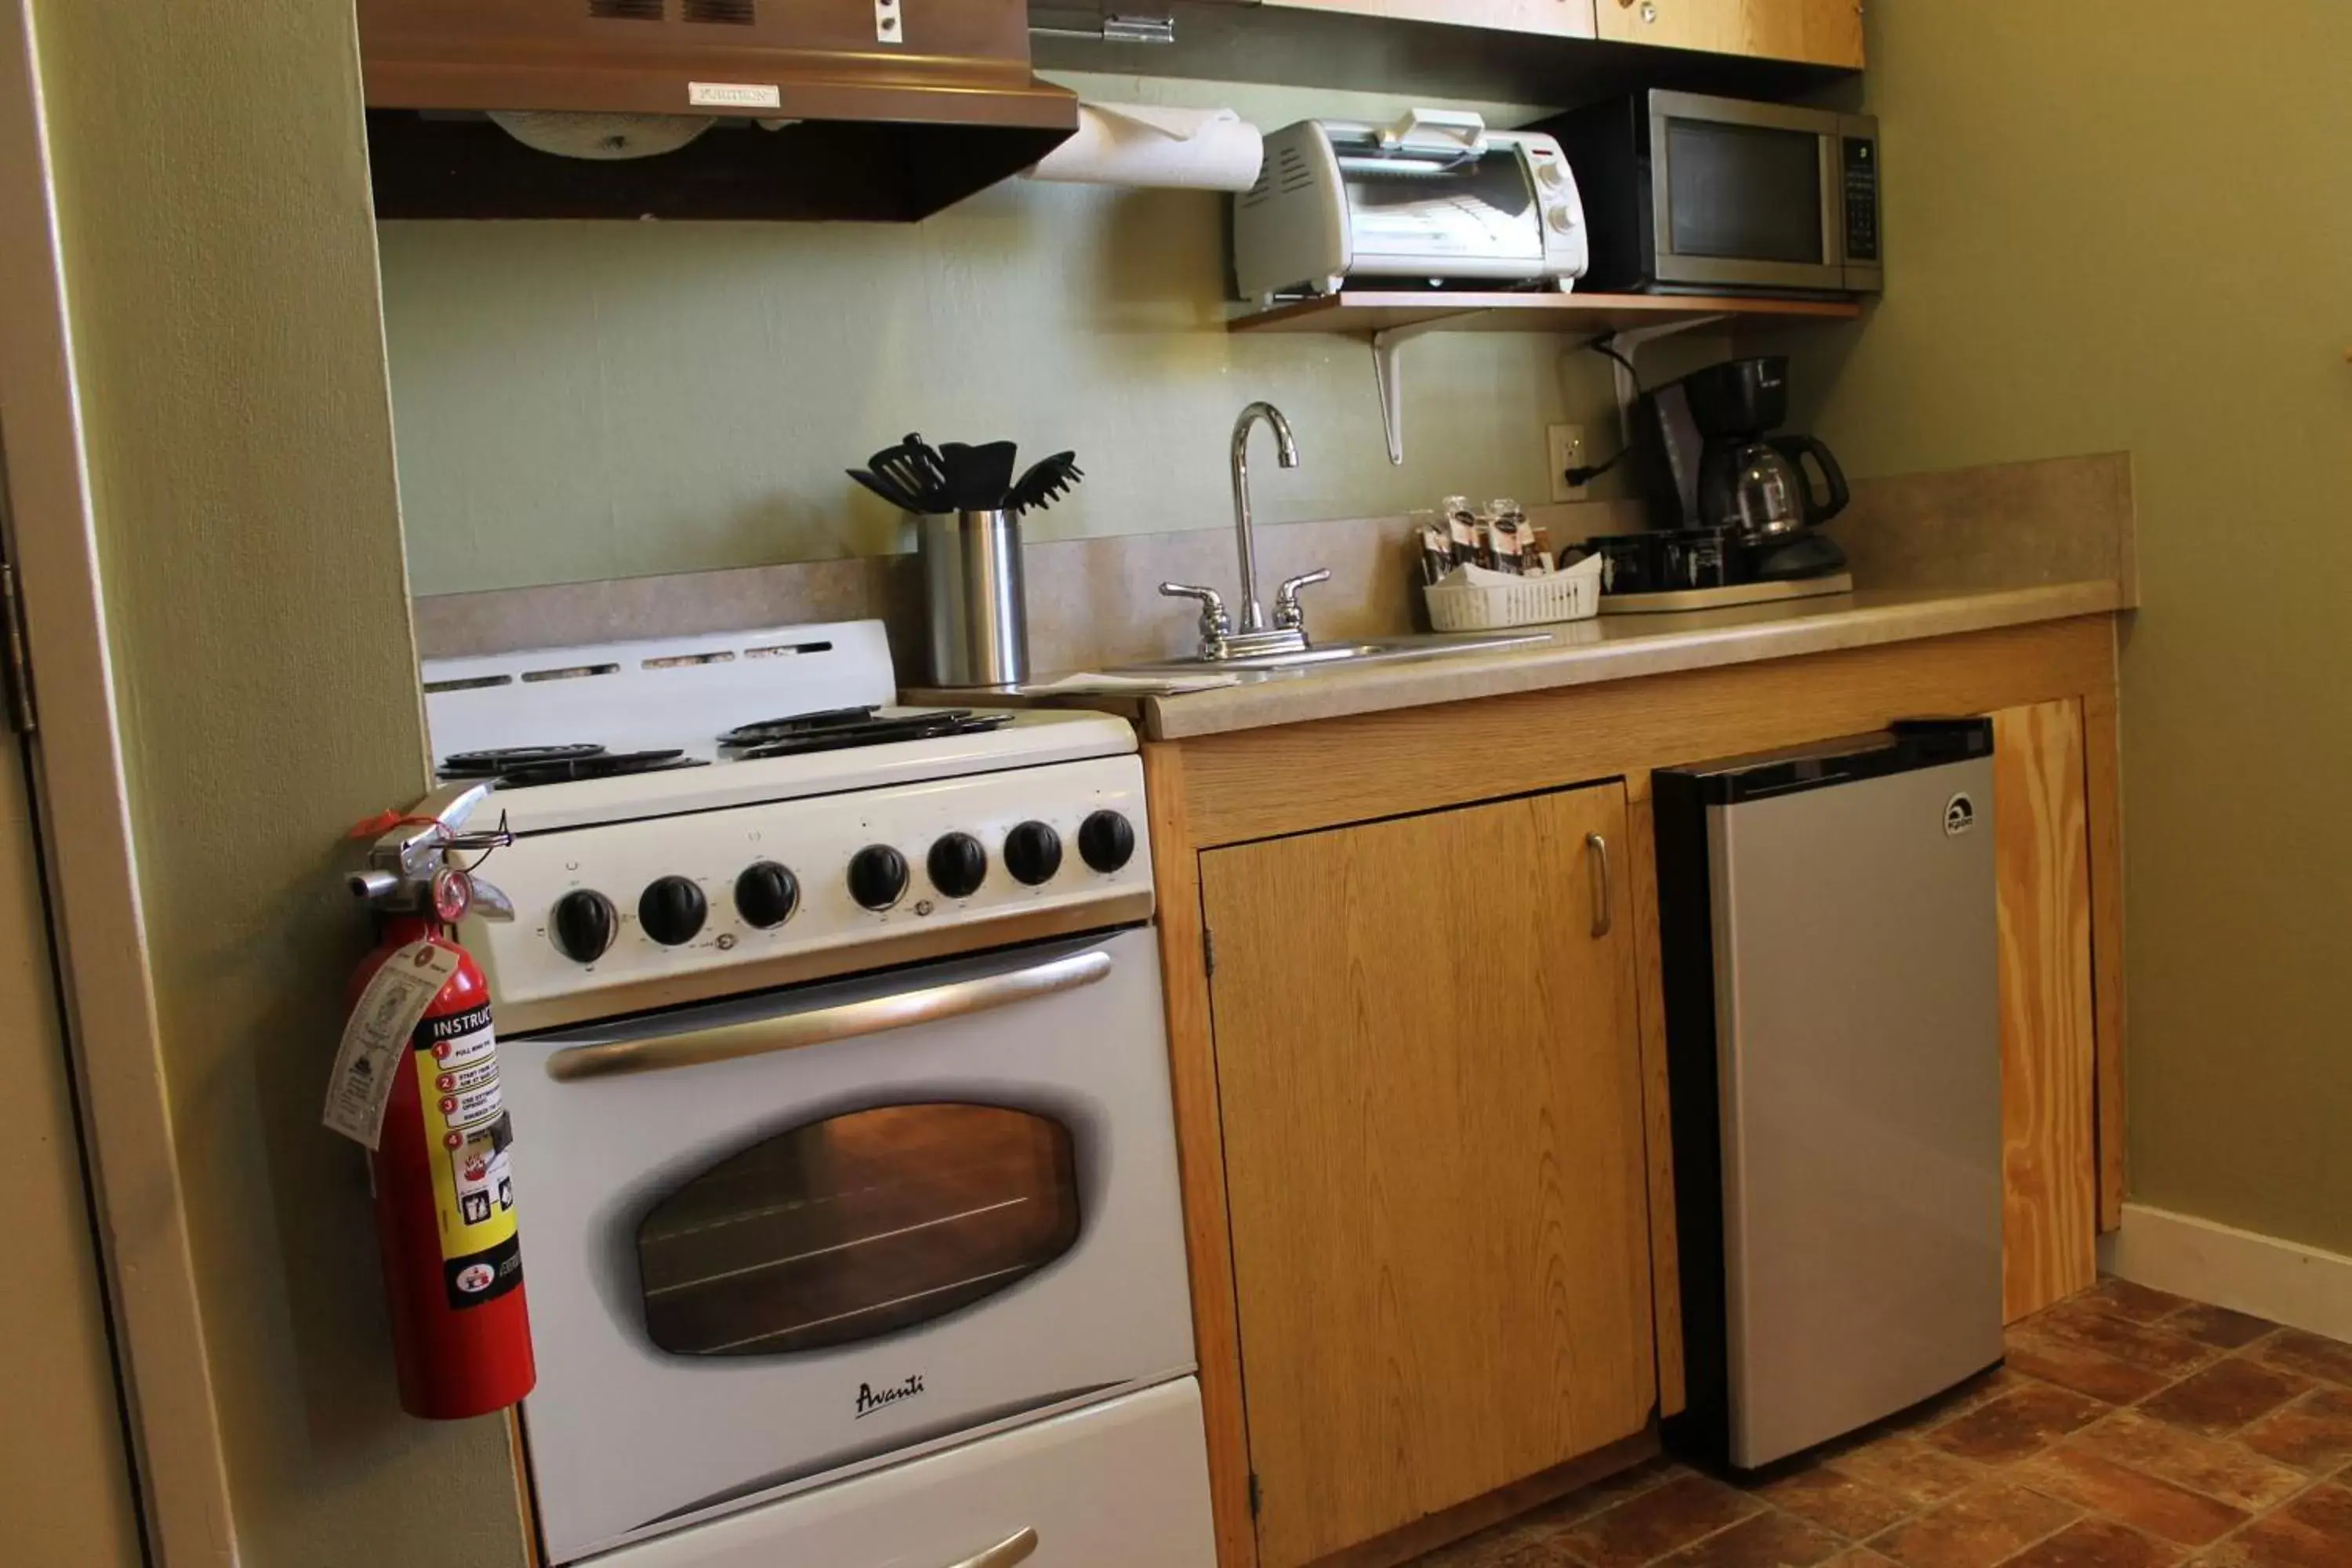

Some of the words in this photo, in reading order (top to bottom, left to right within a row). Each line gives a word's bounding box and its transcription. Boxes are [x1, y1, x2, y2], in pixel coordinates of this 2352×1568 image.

[441, 1078, 449, 1087] 2
[445, 1100, 452, 1110] 3
[449, 1135, 457, 1145] 4
[855, 1374, 925, 1414] Avanti
